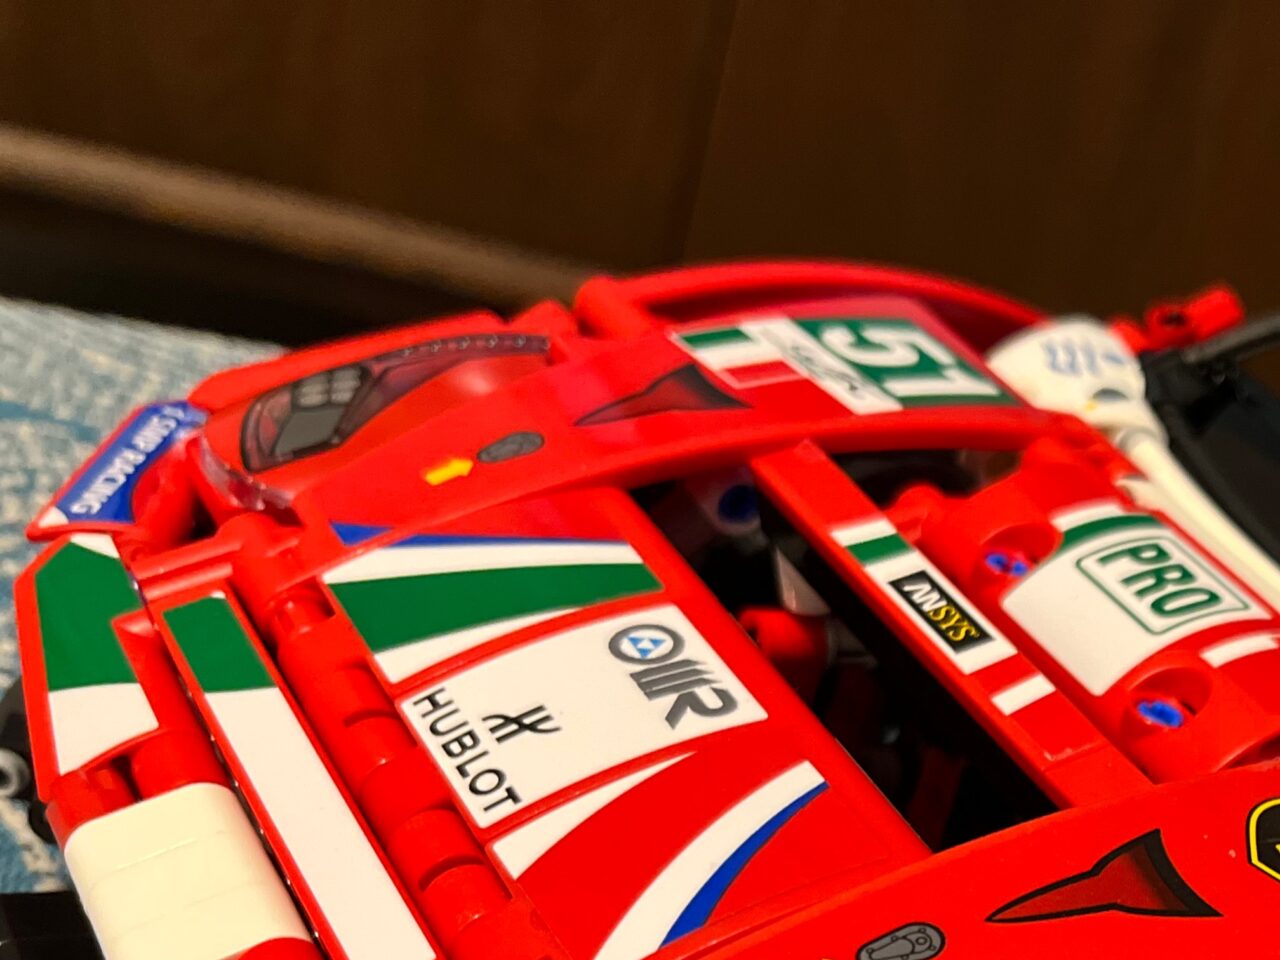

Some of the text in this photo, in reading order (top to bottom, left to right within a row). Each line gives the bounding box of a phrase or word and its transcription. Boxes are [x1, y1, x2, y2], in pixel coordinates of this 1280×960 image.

[902, 583, 978, 642] ANSYS
[1097, 543, 1222, 618] PRO
[412, 687, 522, 812] HUBLOT
